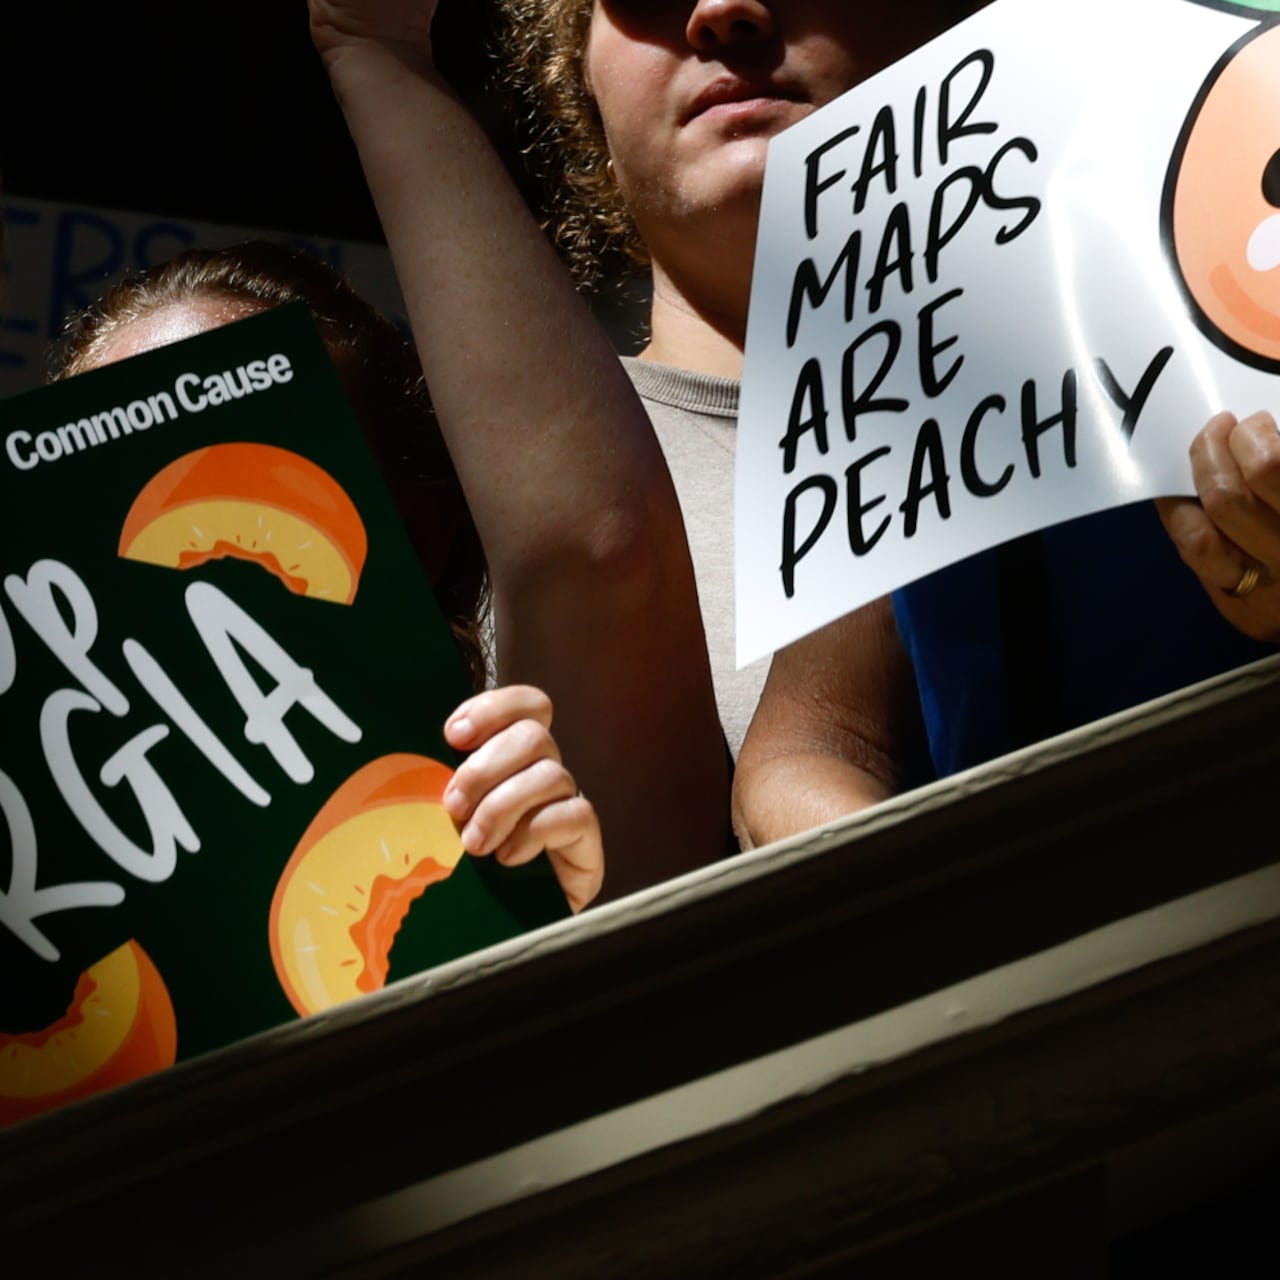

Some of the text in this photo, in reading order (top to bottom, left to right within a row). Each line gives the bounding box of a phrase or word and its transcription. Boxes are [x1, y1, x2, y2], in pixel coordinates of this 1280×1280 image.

[804, 47, 999, 239] FAIR
[784, 137, 1042, 348] MAPS
[6, 352, 295, 471] Common Cause
[779, 345, 1174, 598] PEACHY
[780, 287, 966, 474] ARE
